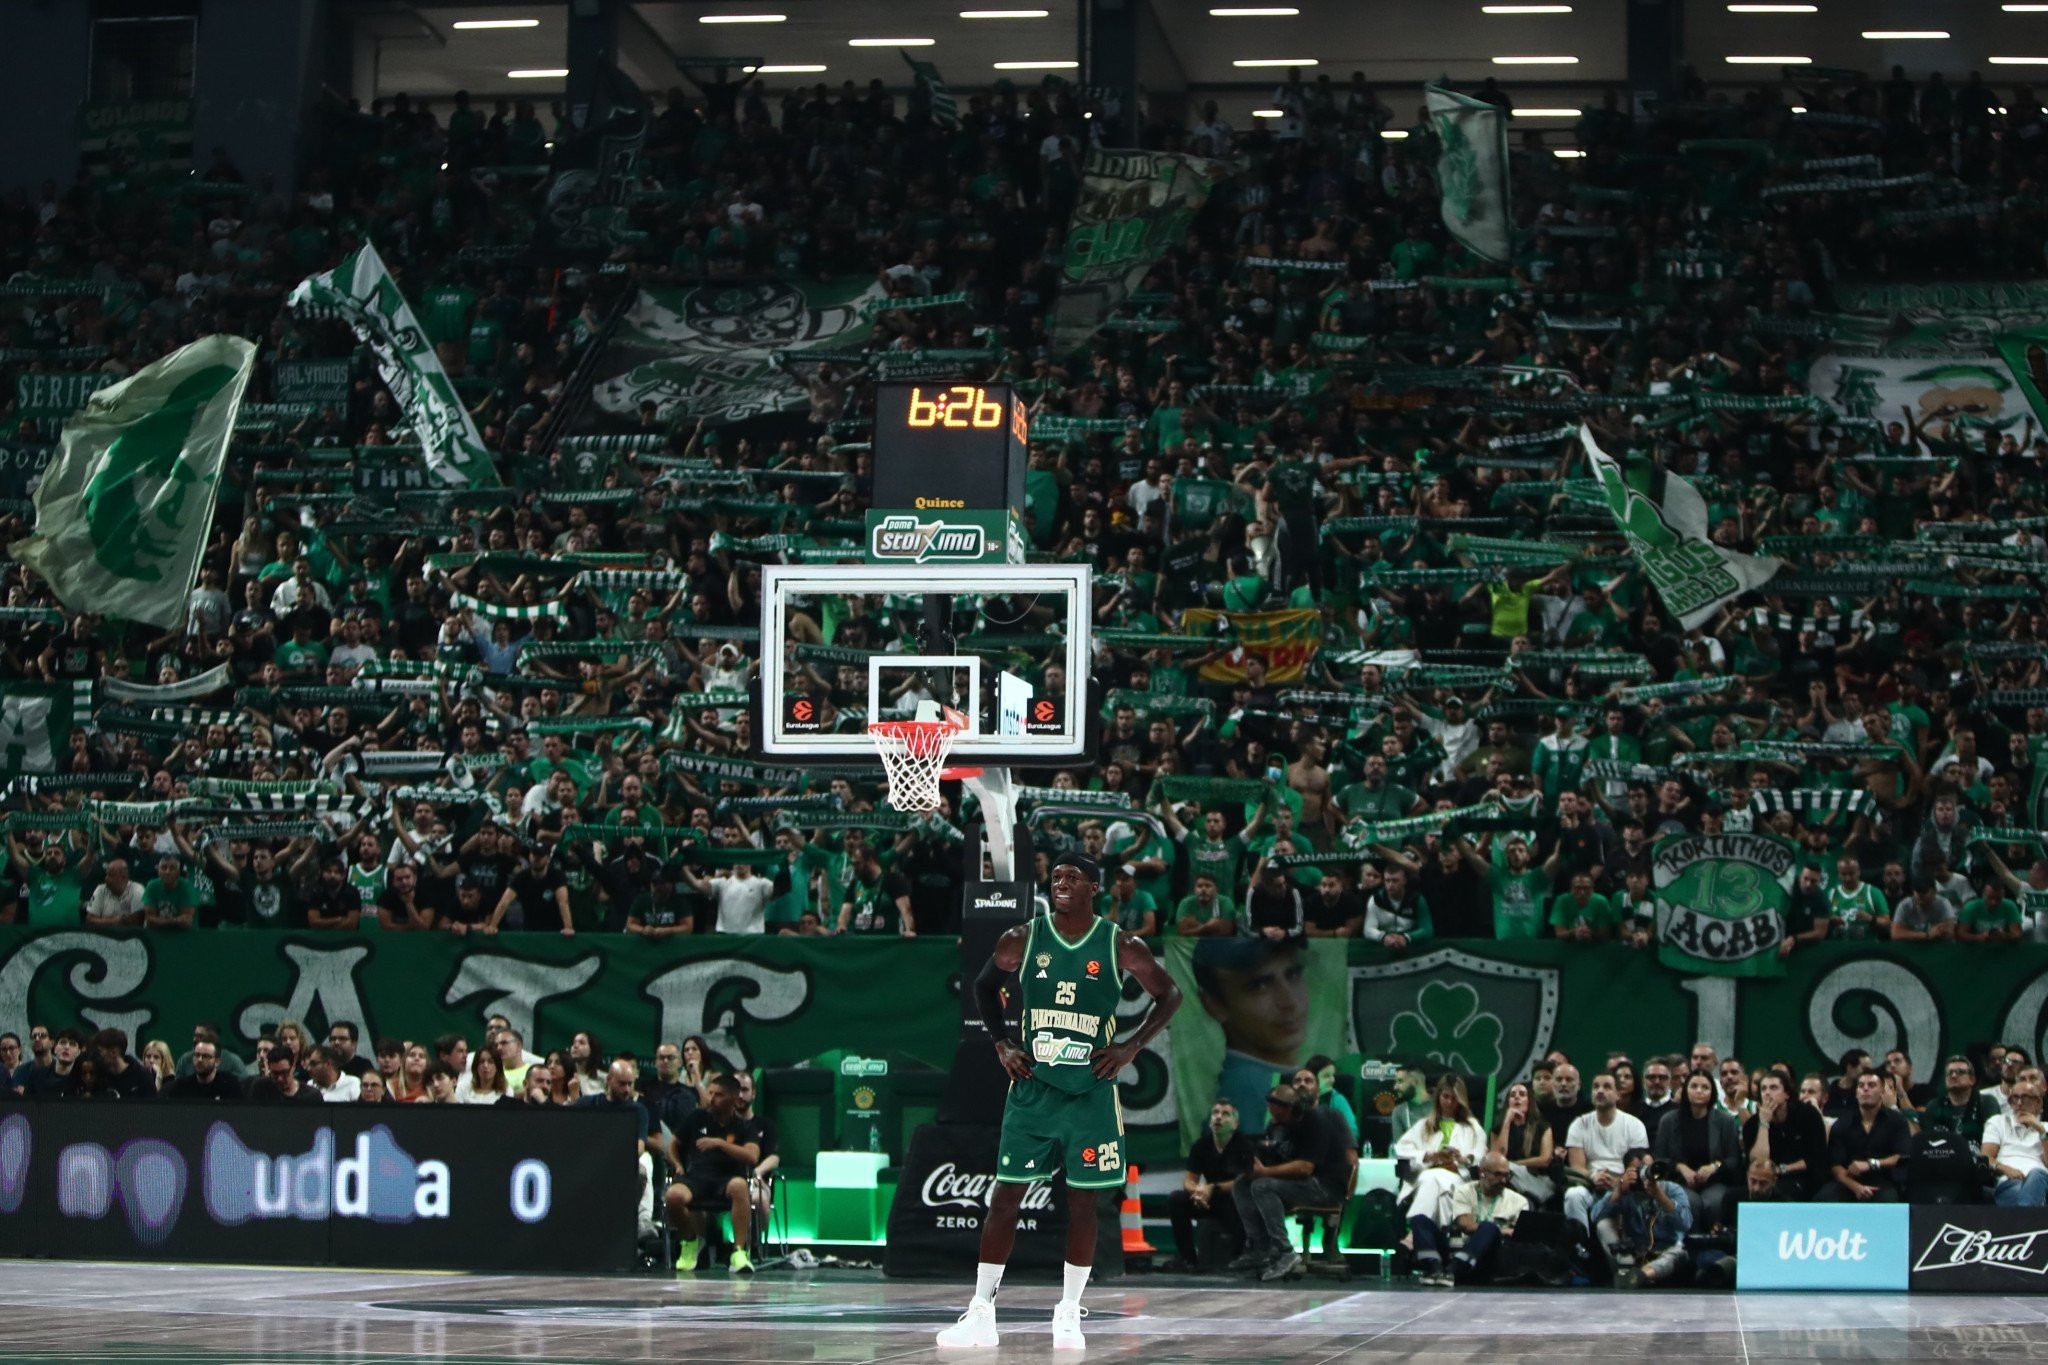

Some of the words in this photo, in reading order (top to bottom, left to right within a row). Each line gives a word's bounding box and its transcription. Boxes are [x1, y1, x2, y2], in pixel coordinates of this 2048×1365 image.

[915, 497, 965, 510] Quince
[785, 722, 820, 730] EuroLeague
[1027, 722, 1062, 730] EuroLeague
[1663, 837, 1790, 874] KORINTHOS
[974, 898, 1017, 909] SPALDING
[1690, 861, 1763, 918] 13
[1671, 911, 1776, 957] ACAB
[1054, 980, 1077, 1006] 25
[1097, 1141, 1121, 1172] 25
[936, 1216, 978, 1229] ZERO
[1778, 1228, 1868, 1260] Wolt
[1943, 1230, 2034, 1264] Bud
